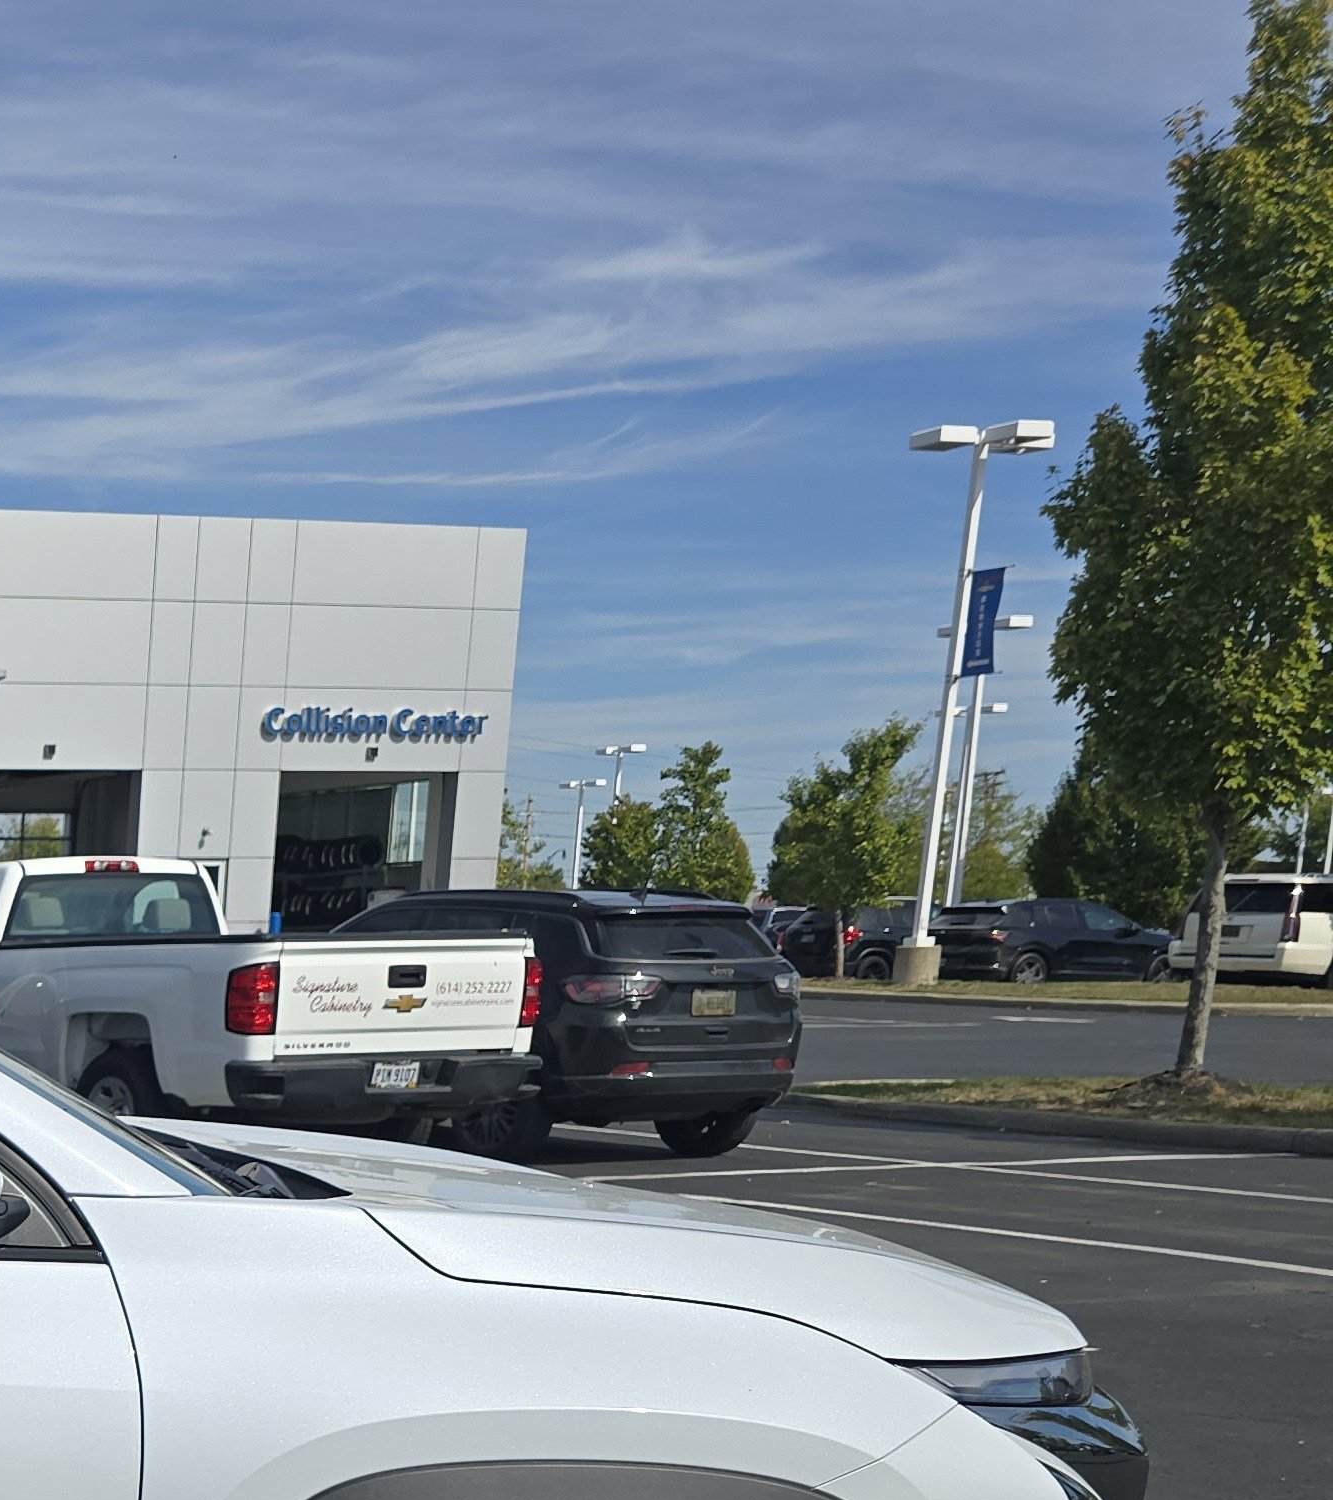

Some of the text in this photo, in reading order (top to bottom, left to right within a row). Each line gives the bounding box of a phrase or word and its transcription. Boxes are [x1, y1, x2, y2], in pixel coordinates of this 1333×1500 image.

[266, 707, 489, 736] Collision Center
[292, 975, 359, 998] Signature
[436, 981, 512, 996] (614) 252-2227
[309, 995, 373, 1018] Cabinetry
